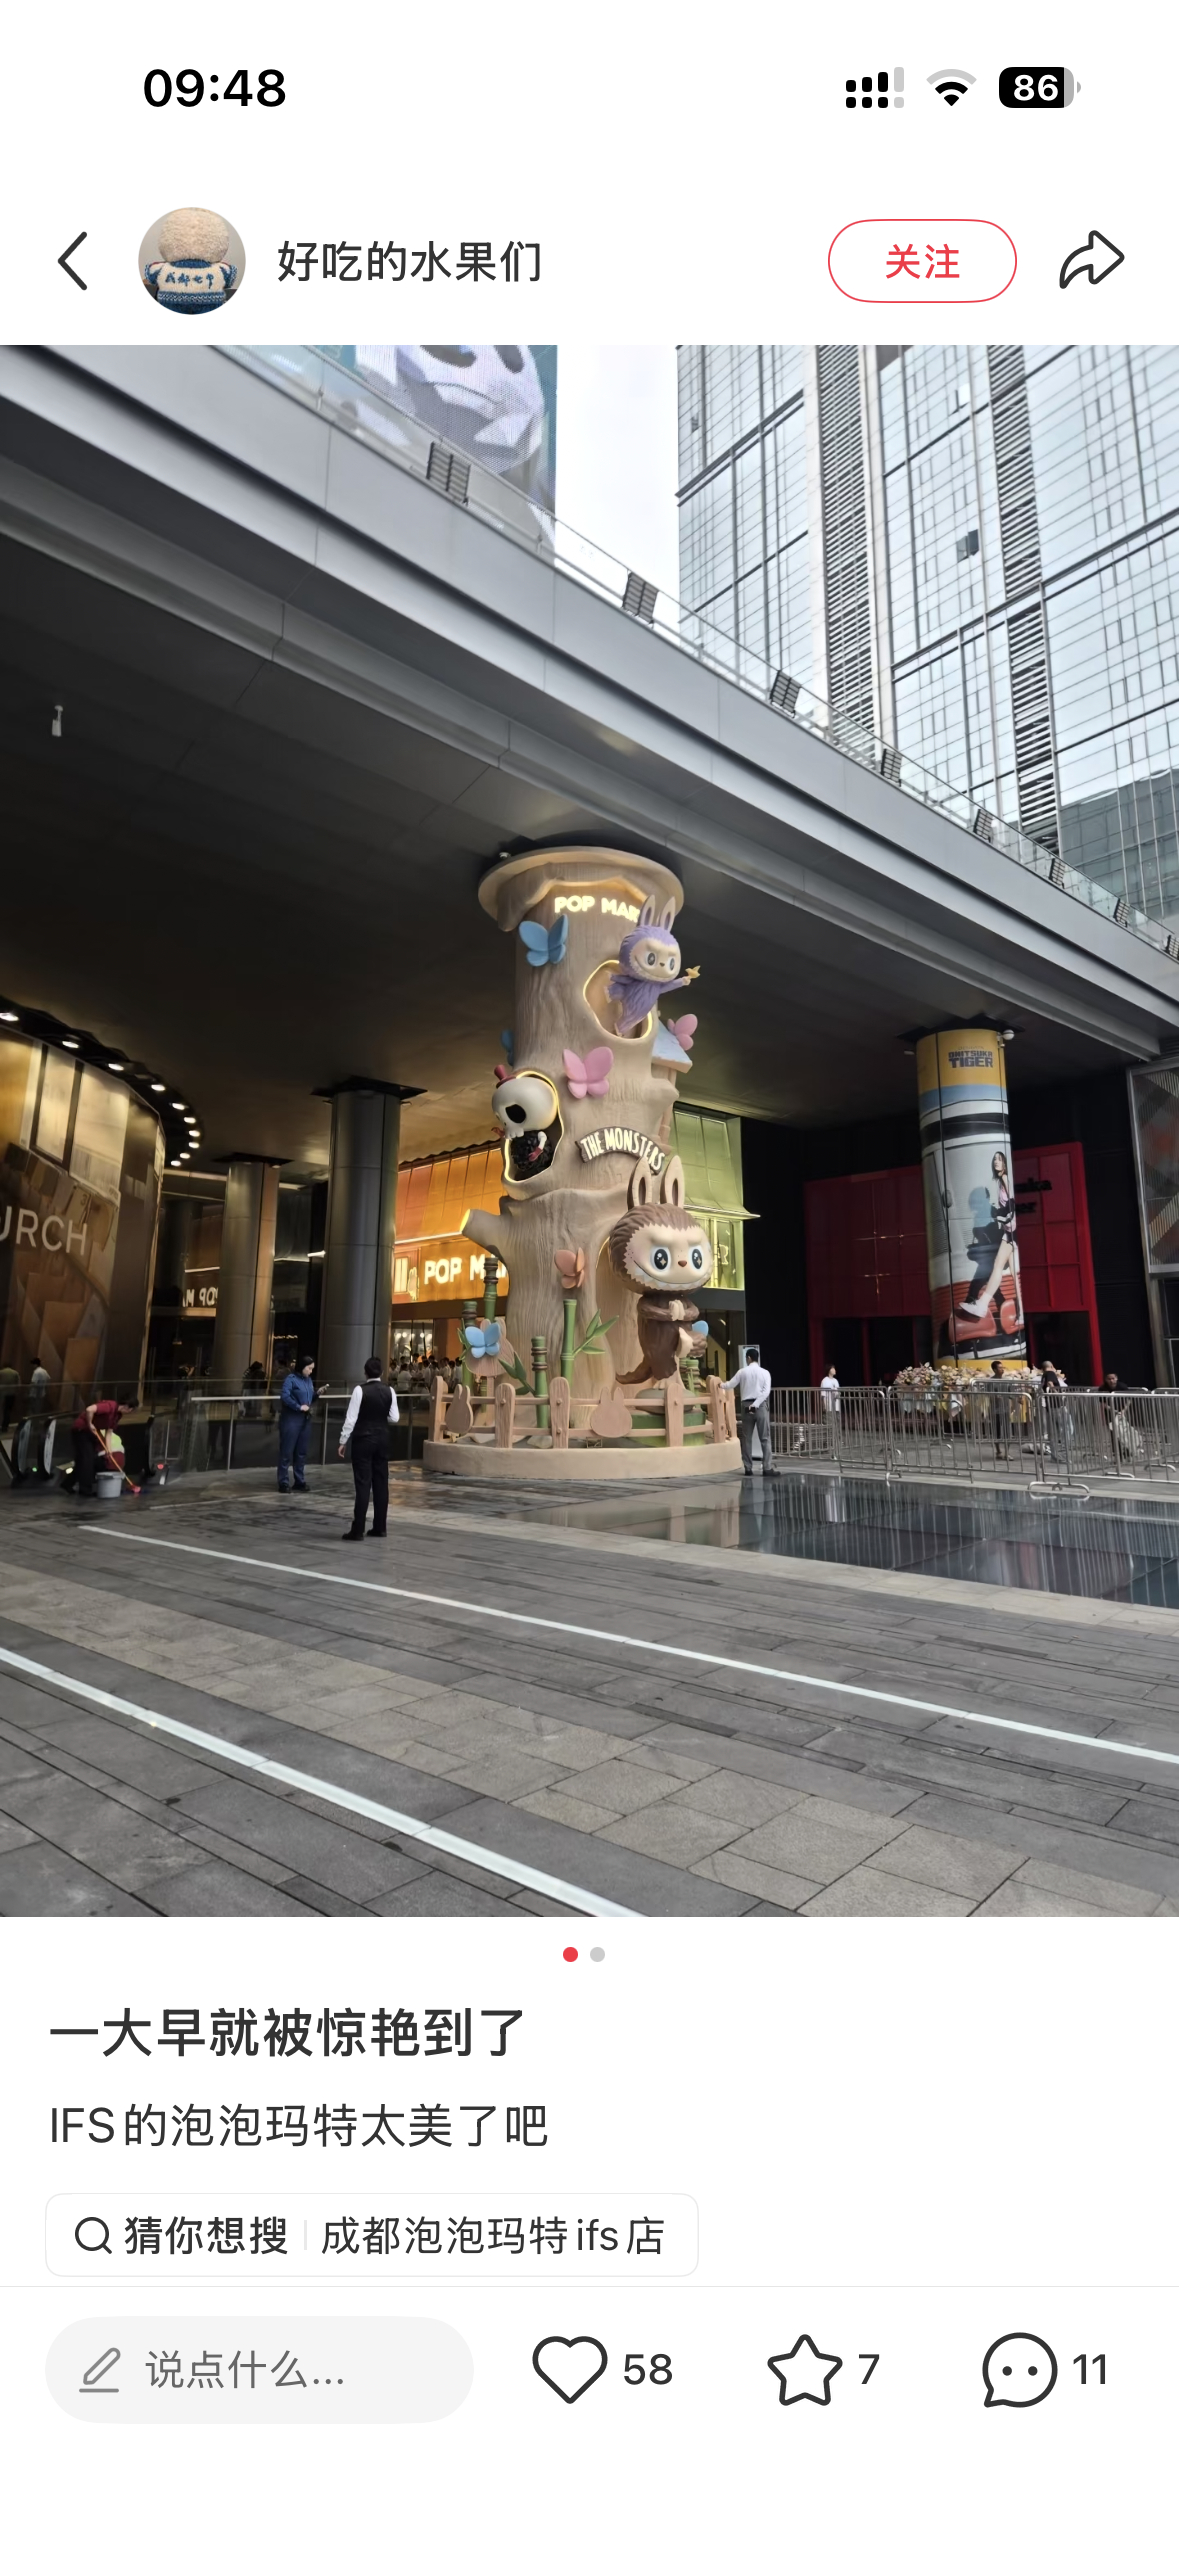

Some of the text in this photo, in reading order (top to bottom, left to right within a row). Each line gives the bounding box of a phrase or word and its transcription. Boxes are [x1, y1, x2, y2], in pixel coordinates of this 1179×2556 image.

[554, 895, 595, 914] POP
[948, 1056, 994, 1069] TIGER
[580, 1127, 666, 1171] THE MONSTERS
[424, 1257, 463, 1285] POP
